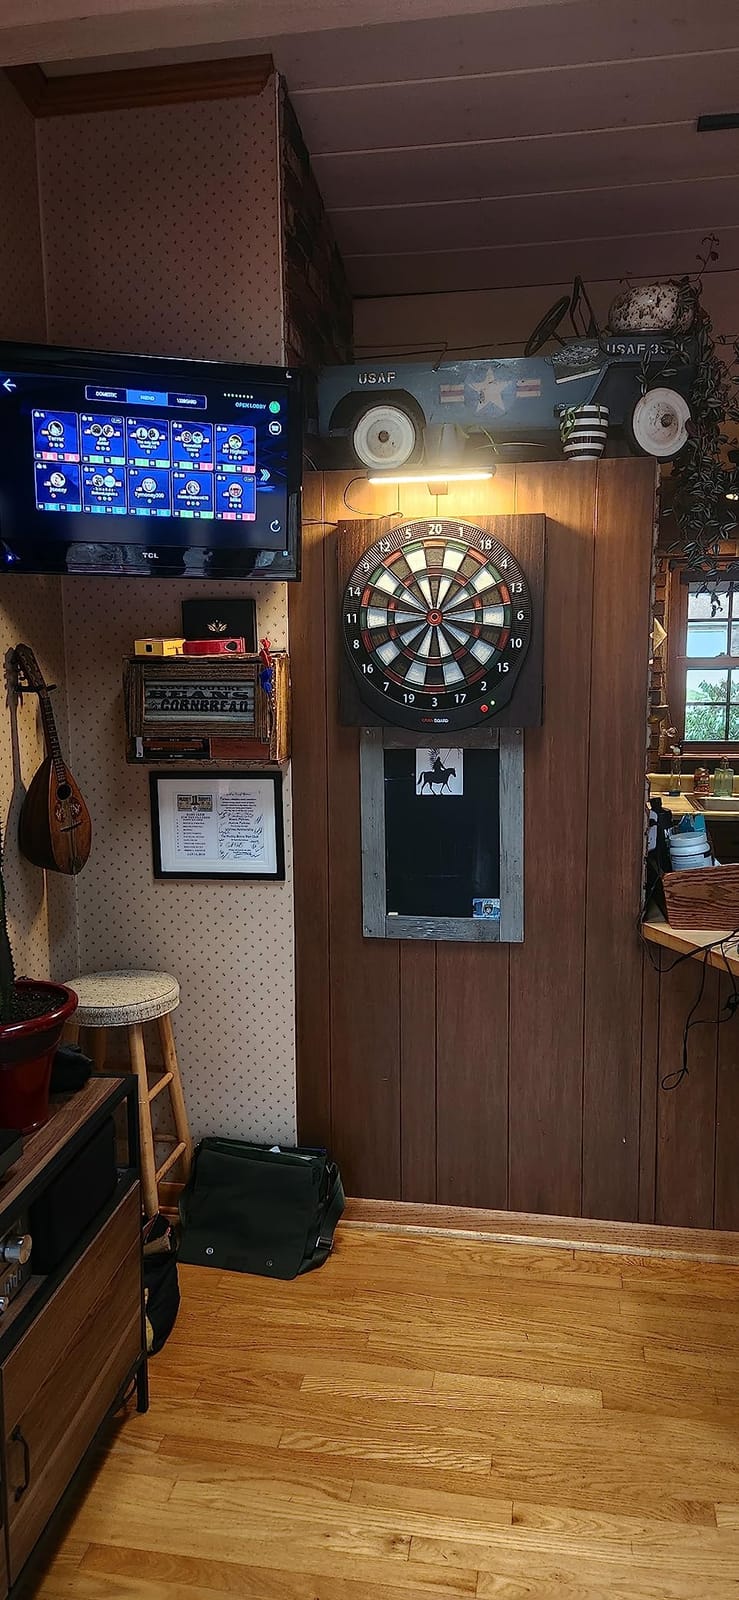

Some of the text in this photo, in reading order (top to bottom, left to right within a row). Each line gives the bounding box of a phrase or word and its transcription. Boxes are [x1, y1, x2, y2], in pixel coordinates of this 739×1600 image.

[606, 343, 646, 355] USAF
[358, 372, 396, 384] USAF
[235, 401, 249, 409] OPEN
[405, 528, 412, 538] 5
[428, 523, 442, 535] 20
[458, 527, 464, 538] 1
[378, 541, 390, 552] 12
[480, 539, 492, 550] 18
[362, 562, 370, 572] 9
[500, 559, 508, 569] 4
[349, 586, 361, 597] 14
[510, 583, 523, 593] 13
[346, 614, 357, 624] 11
[516, 610, 524, 620] 6
[353, 640, 360, 649] 8
[510, 638, 522, 648] 10
[362, 663, 374, 674] 16
[497, 662, 509, 673] 15
[383, 682, 390, 692] 7
[480, 681, 487, 691] 2
[147, 690, 249, 700] BEANS
[403, 693, 415, 704] 19
[454, 693, 467, 704] 17
[160, 699, 249, 713] CORNBREAD
[431, 698, 438, 708] 3
